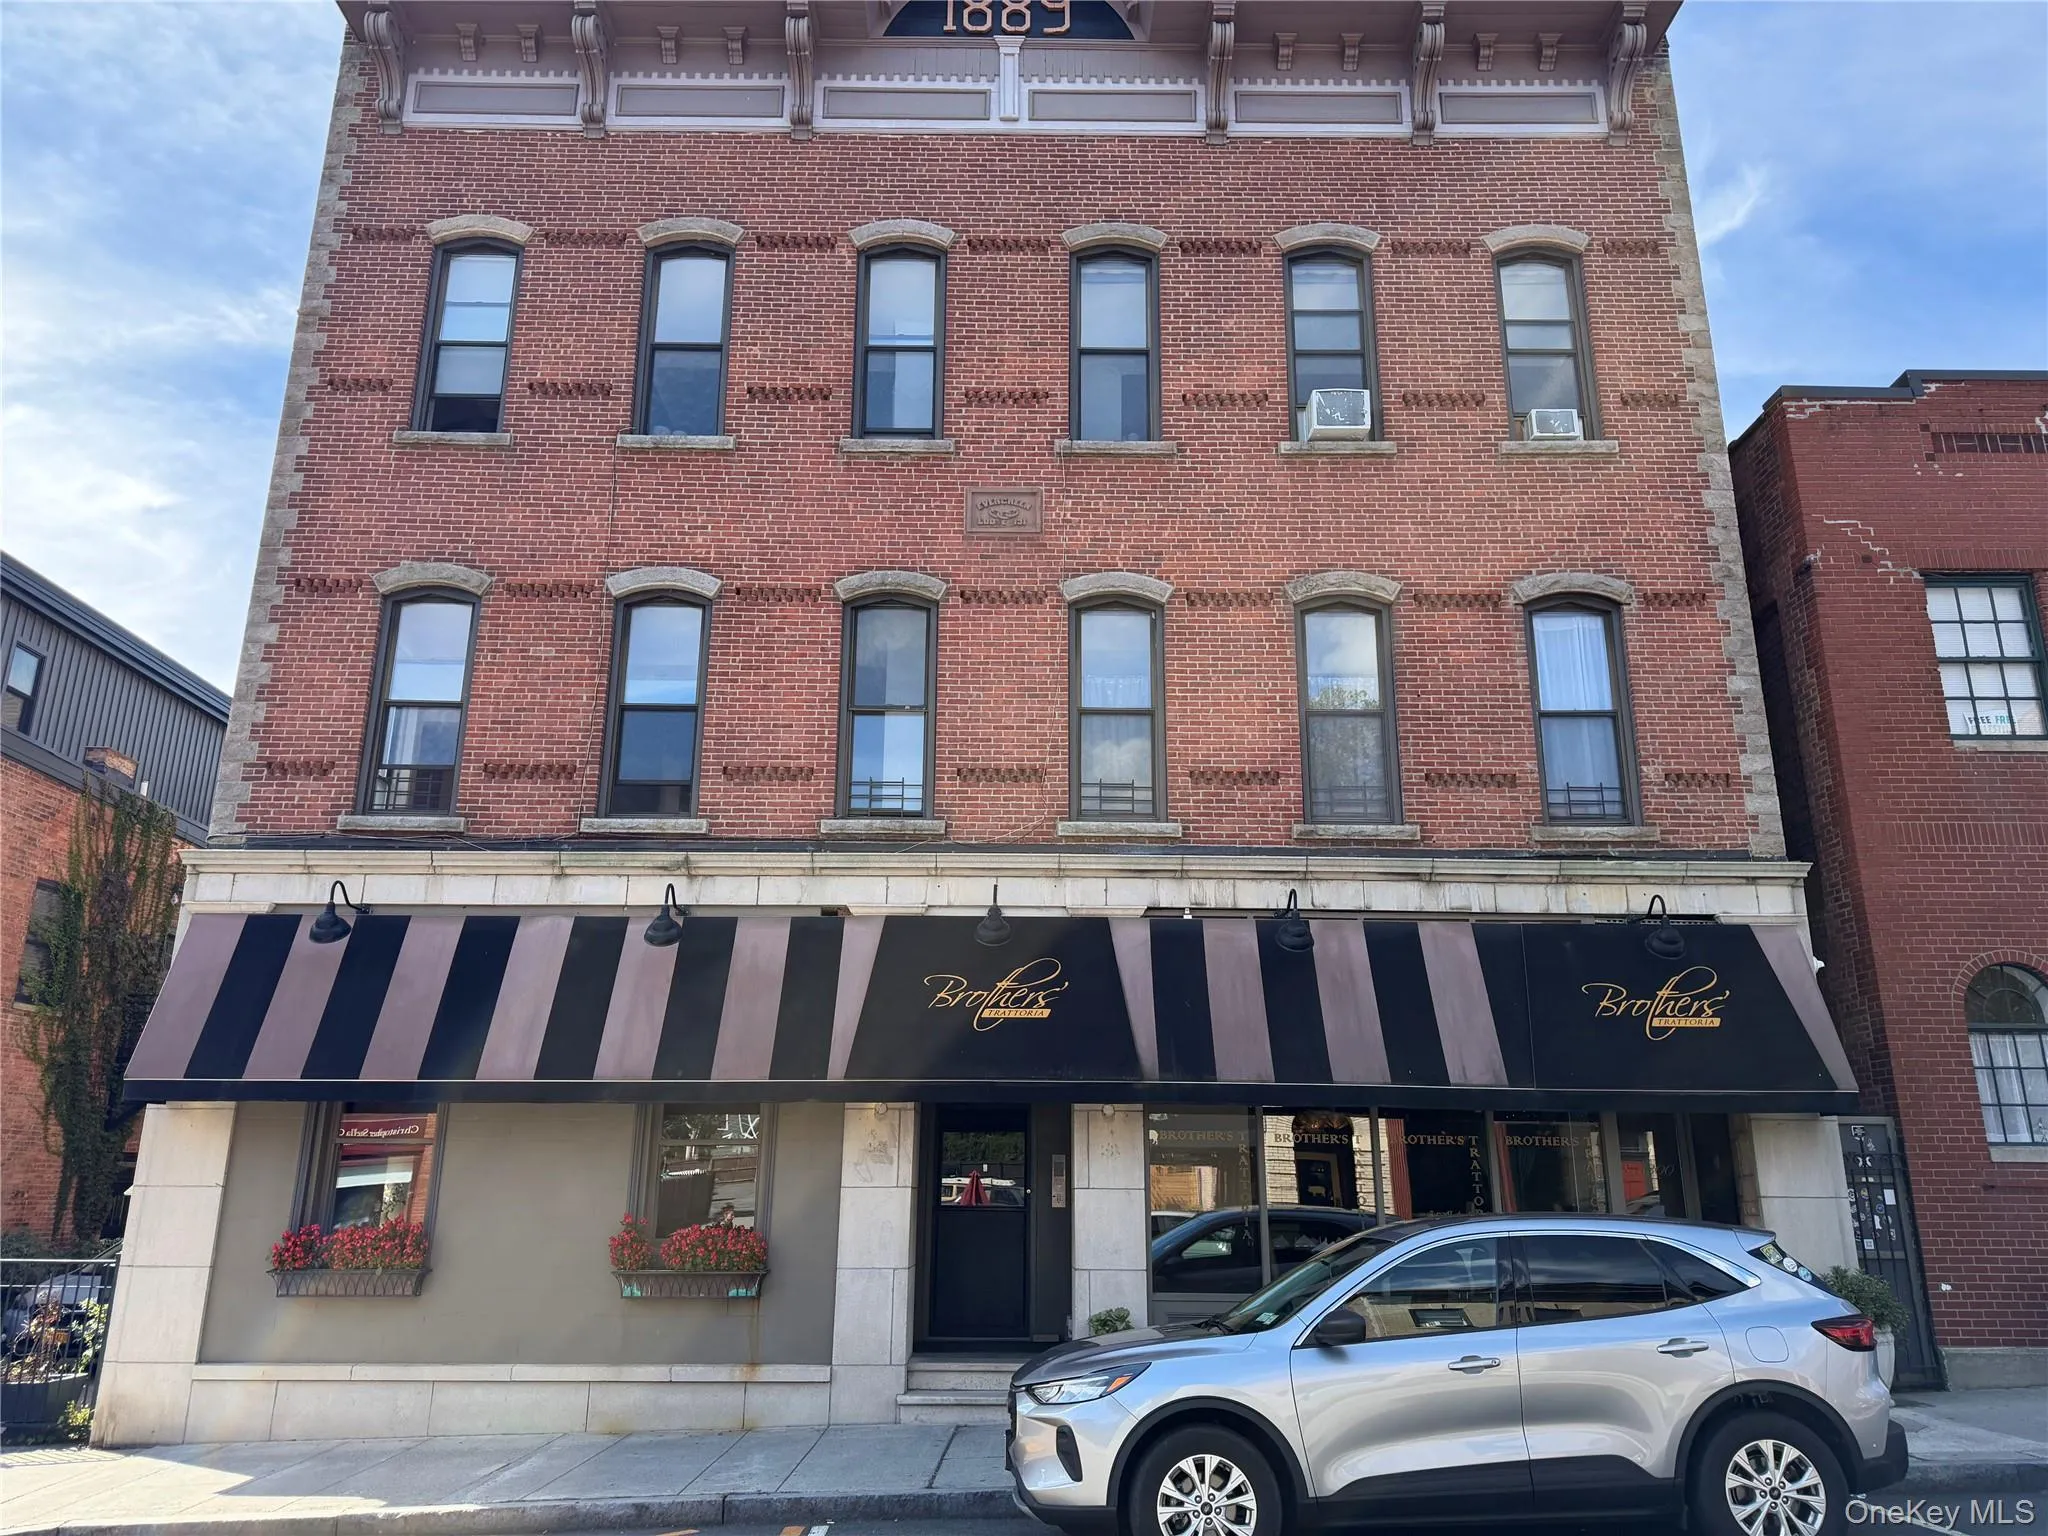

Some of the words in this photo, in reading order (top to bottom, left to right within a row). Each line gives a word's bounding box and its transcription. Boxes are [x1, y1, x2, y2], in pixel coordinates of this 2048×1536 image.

[943, 0, 1071, 33] 1889
[1968, 715, 1992, 725] FEE
[987, 1009, 1045, 1017] TRATTORIA
[1657, 1018, 1715, 1026] TRATTORIA
[1159, 1130, 1234, 1142] BROTHER'S
[1274, 1133, 1350, 1145] BROTHER'S
[1391, 1134, 1465, 1145] ROTHER'S
[1504, 1135, 1580, 1146] BROTHERS
